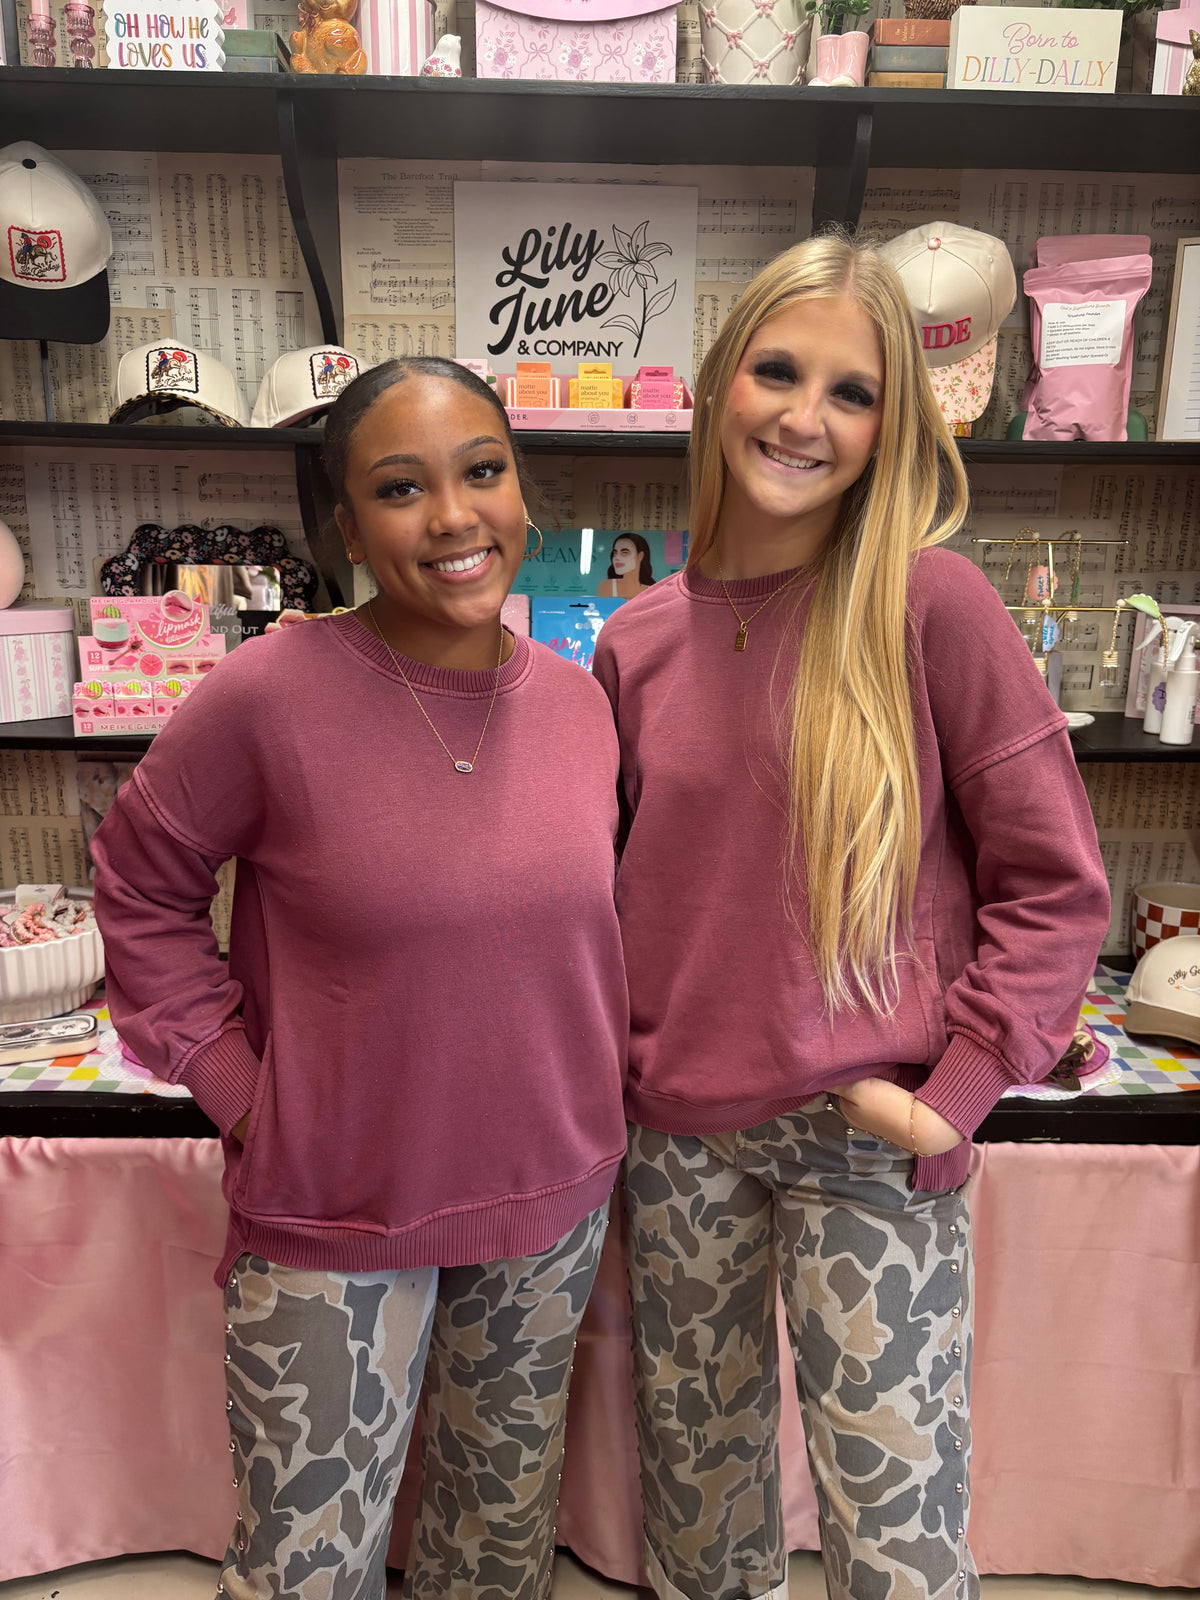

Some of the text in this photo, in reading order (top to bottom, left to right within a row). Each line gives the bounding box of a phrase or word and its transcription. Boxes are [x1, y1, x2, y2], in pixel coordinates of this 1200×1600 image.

[114, 12, 140, 38] OH
[146, 13, 185, 38] HOW
[1002, 22, 1079, 55] Born to
[961, 55, 1114, 87] DILLY-DALLY
[381, 172, 397, 180] The
[495, 222, 605, 289] Lily
[487, 282, 616, 356] June
[921, 315, 972, 349] IDE
[517, 339, 624, 357] & COMPANY
[154, 613, 202, 639] lipmask
[211, 624, 259, 635] ND OUT
